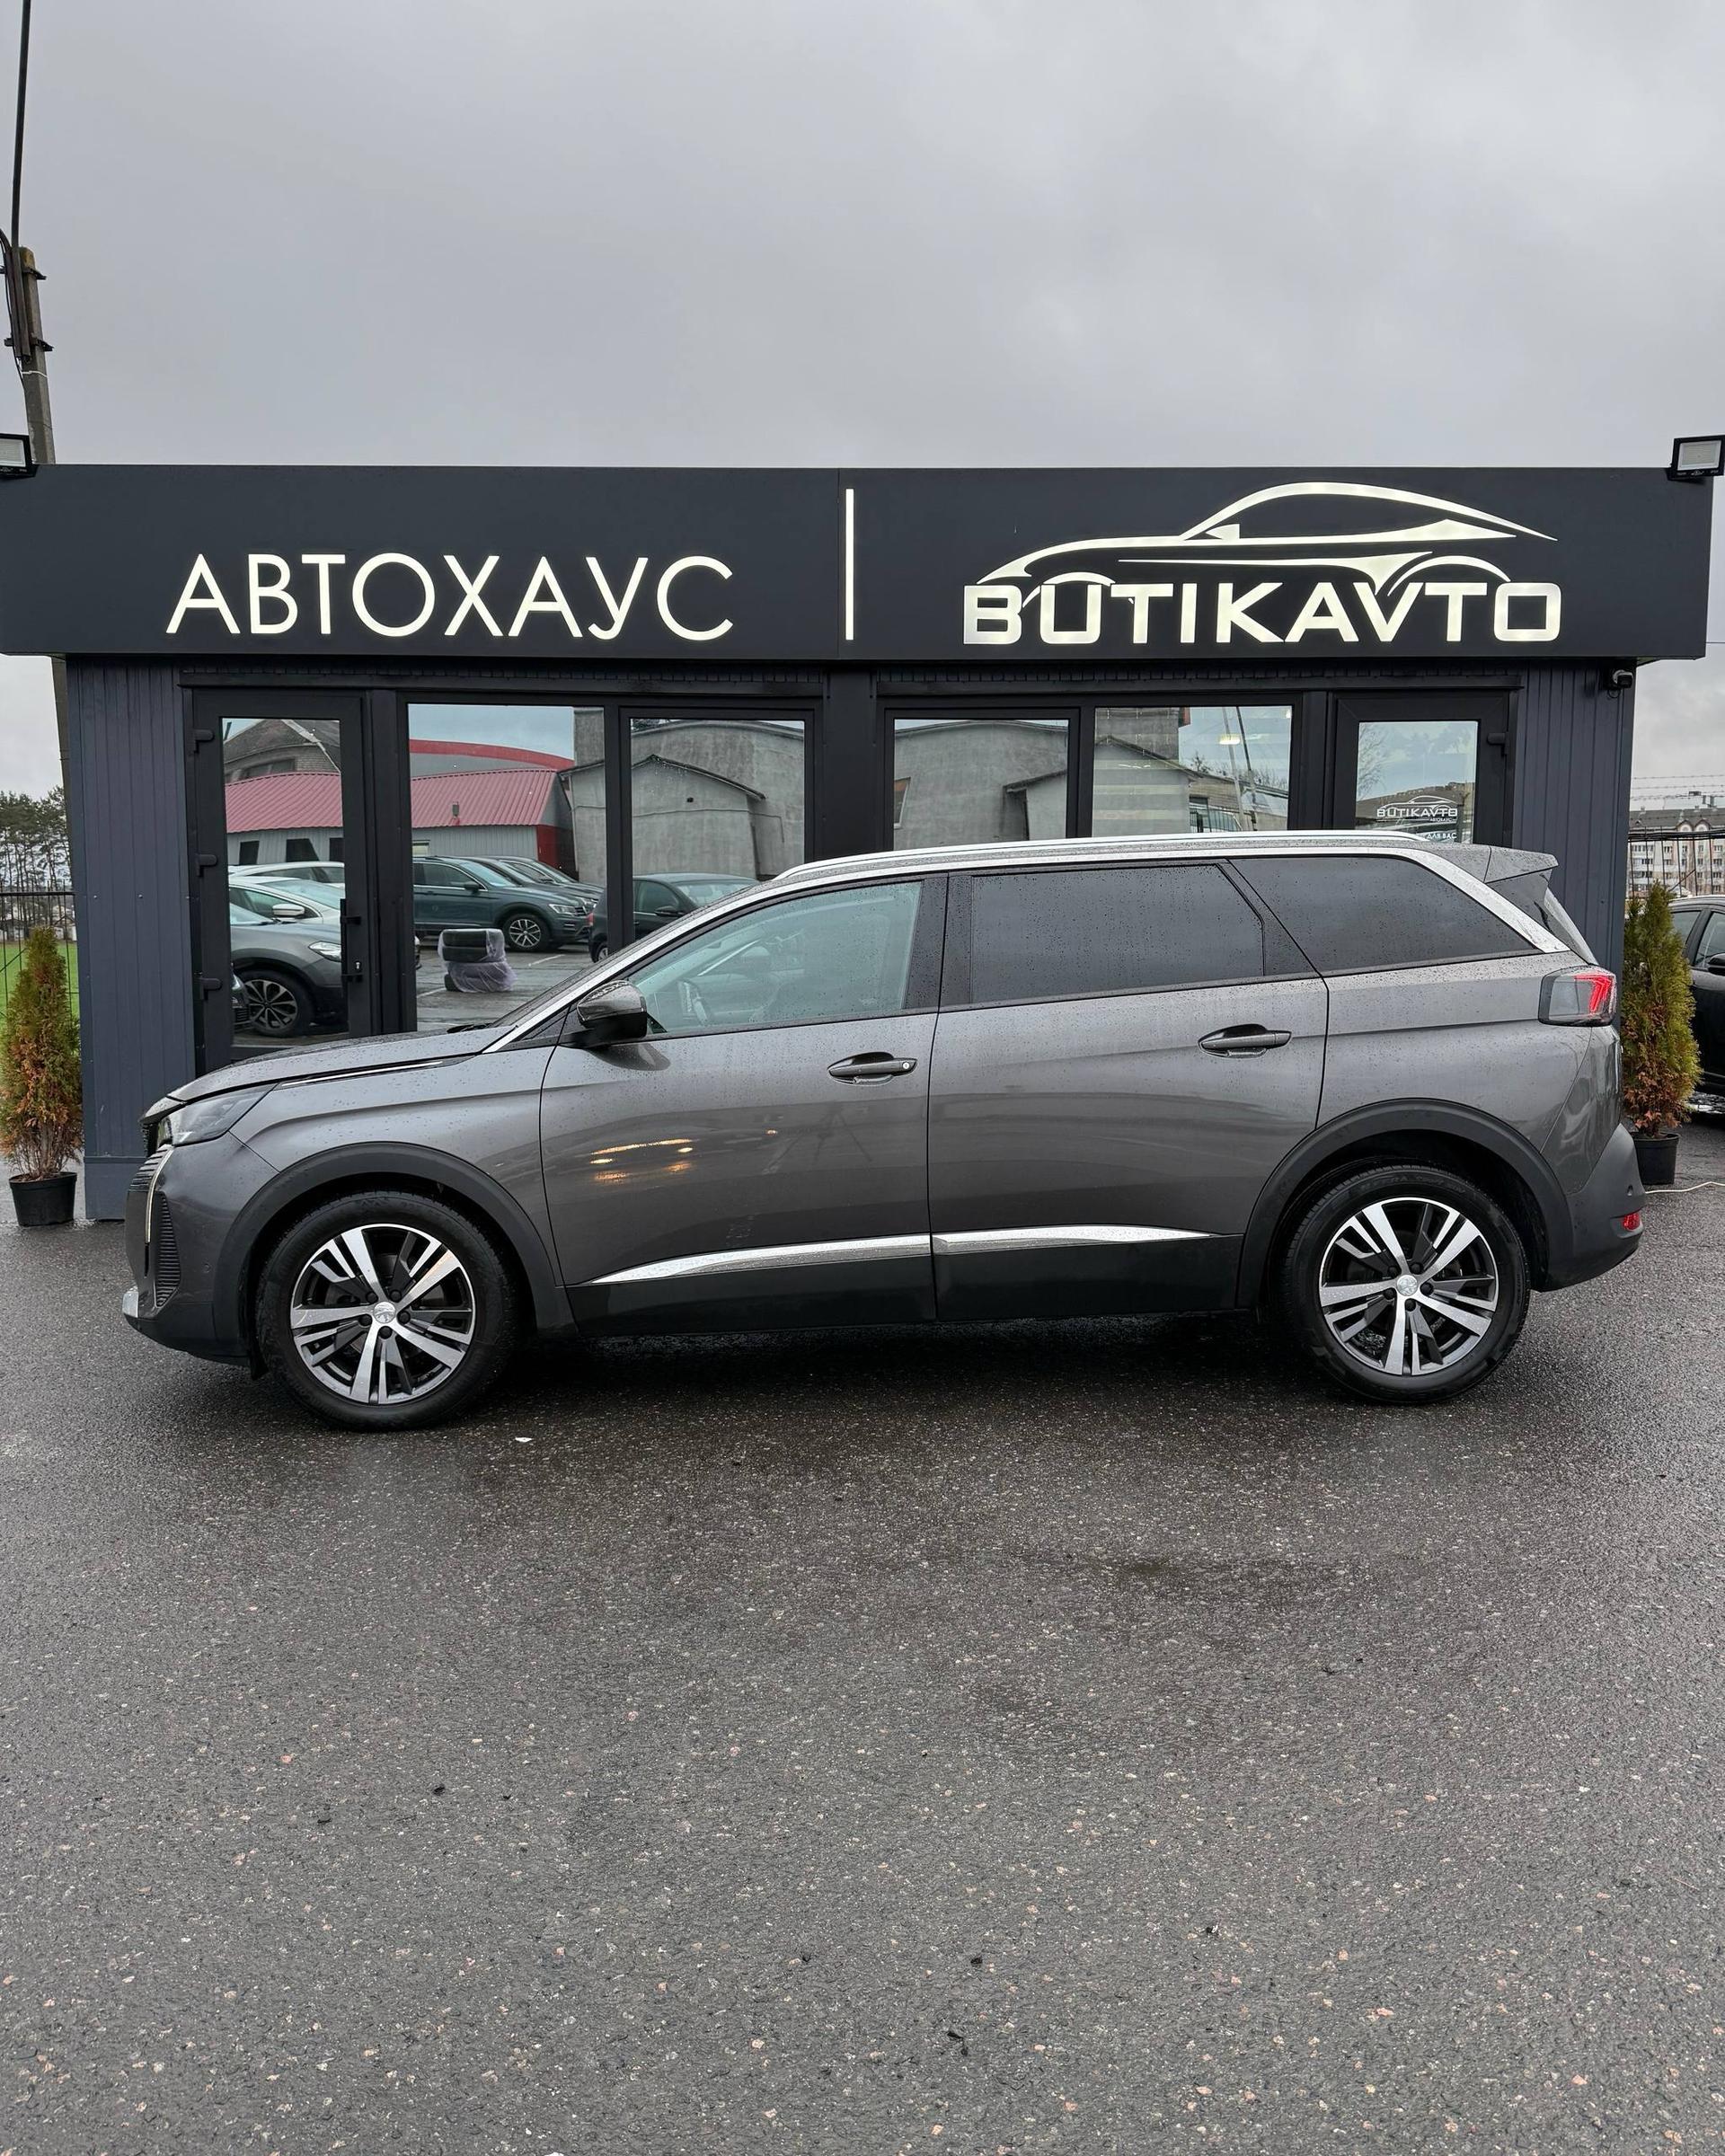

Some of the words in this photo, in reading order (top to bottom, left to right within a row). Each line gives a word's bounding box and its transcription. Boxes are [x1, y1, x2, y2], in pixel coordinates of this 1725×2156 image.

[166, 553, 733, 641] АВТОХАУС
[964, 581, 1561, 645] BUTIKAVTO
[1376, 808, 1457, 817] BUTIKAVTO
